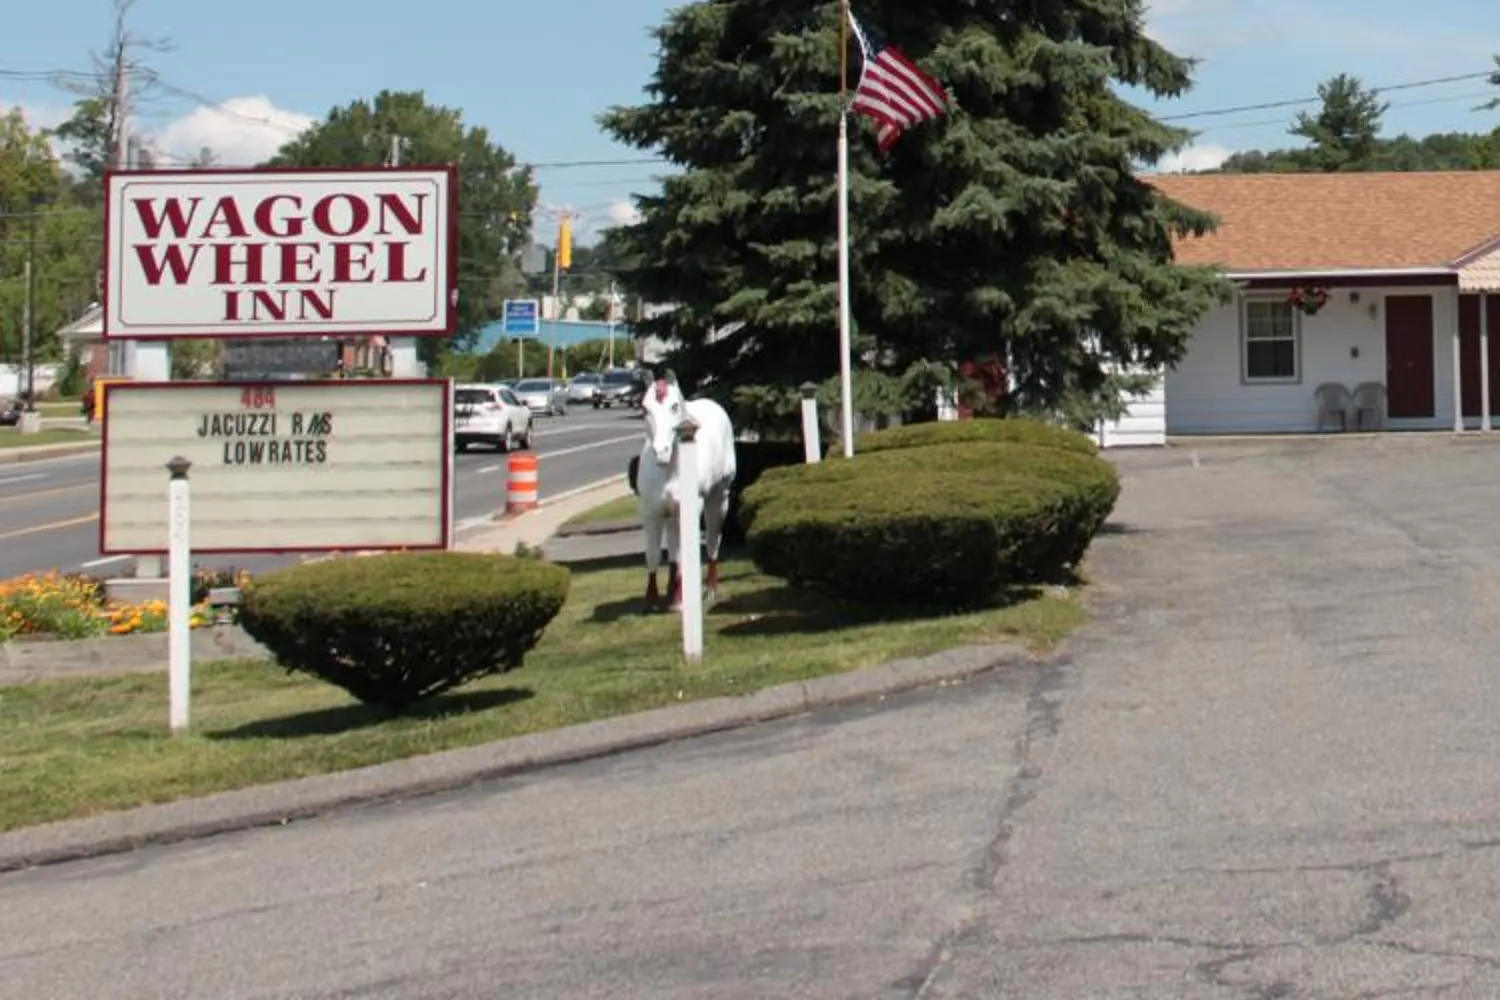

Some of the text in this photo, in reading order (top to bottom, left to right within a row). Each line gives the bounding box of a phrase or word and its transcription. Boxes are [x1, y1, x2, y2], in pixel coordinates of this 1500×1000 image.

[131, 193, 429, 239] WAGON
[132, 241, 427, 285] WHEEL
[222, 289, 337, 321] INN
[198, 413, 276, 437] JACUZZI
